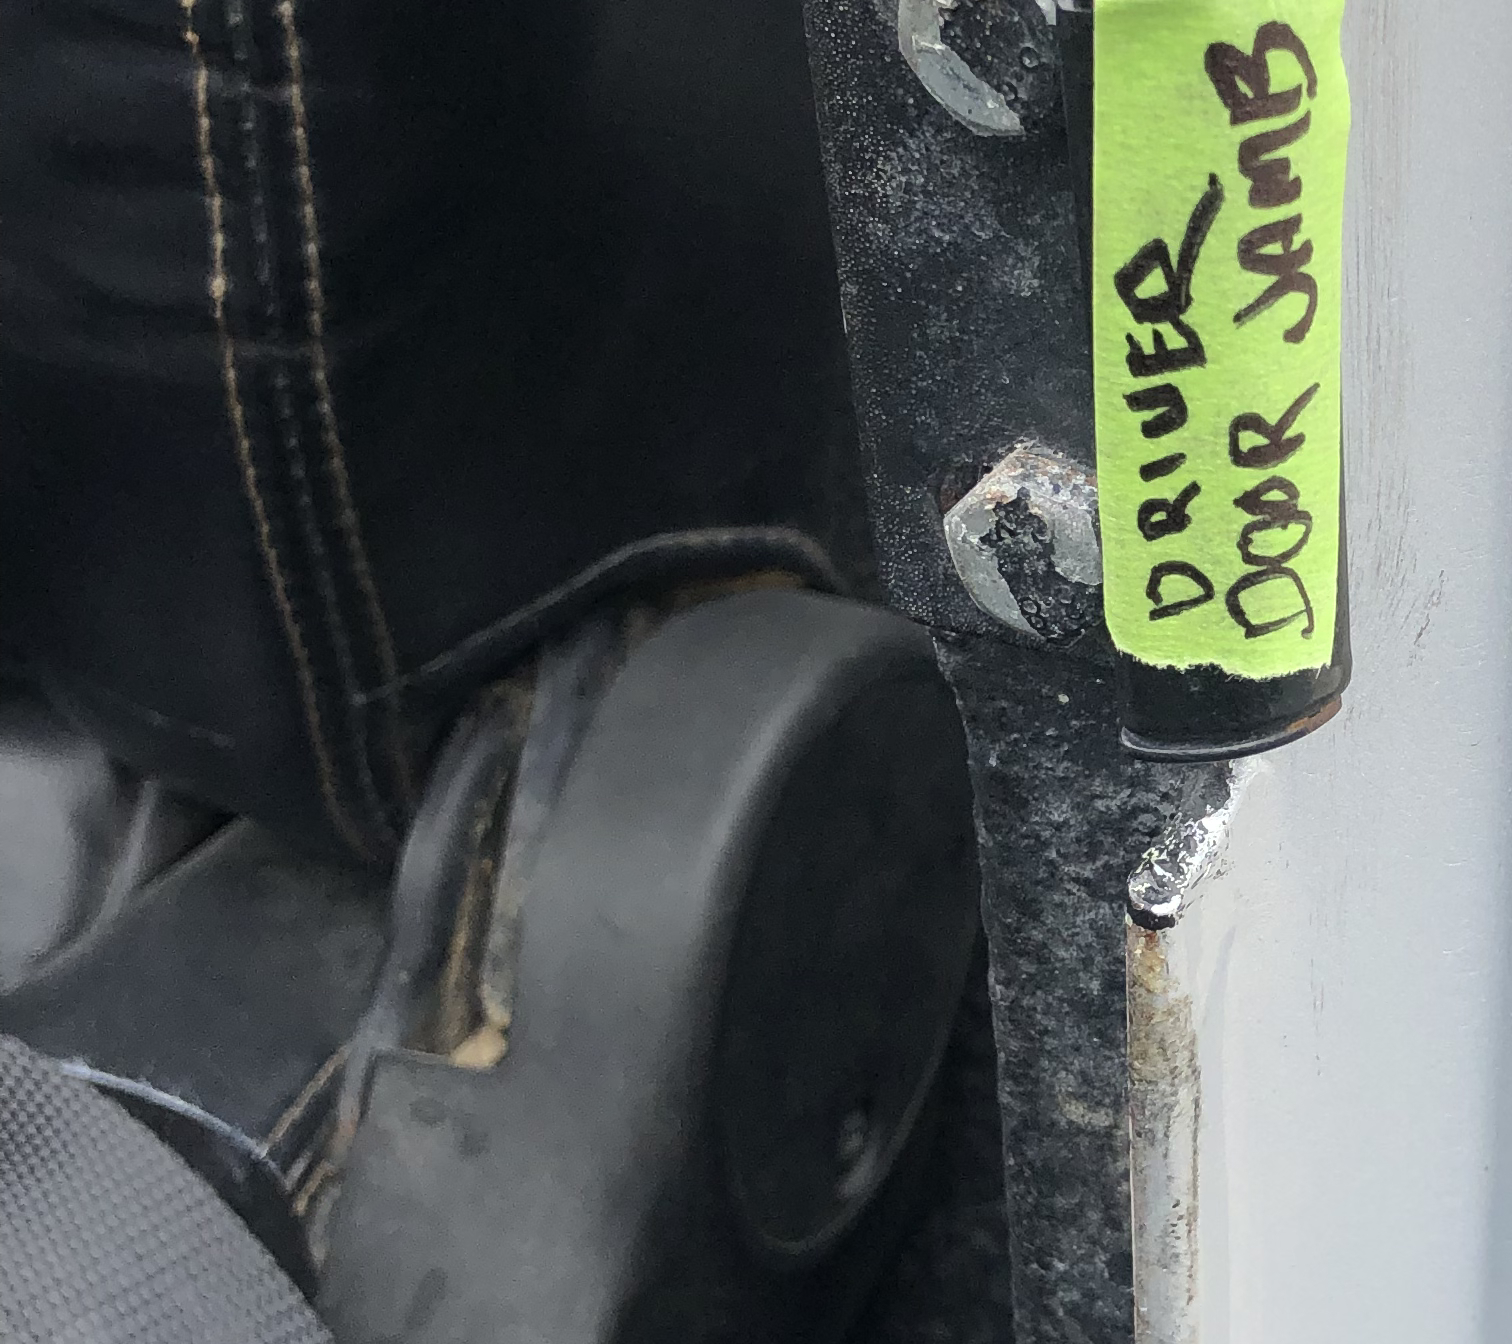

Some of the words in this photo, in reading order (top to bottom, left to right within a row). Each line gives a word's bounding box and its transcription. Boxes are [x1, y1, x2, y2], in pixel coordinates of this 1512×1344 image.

[1204, 20, 1318, 344] JAMB
[1113, 173, 1225, 621] DRIVER
[1225, 382, 1320, 641] DOOR
